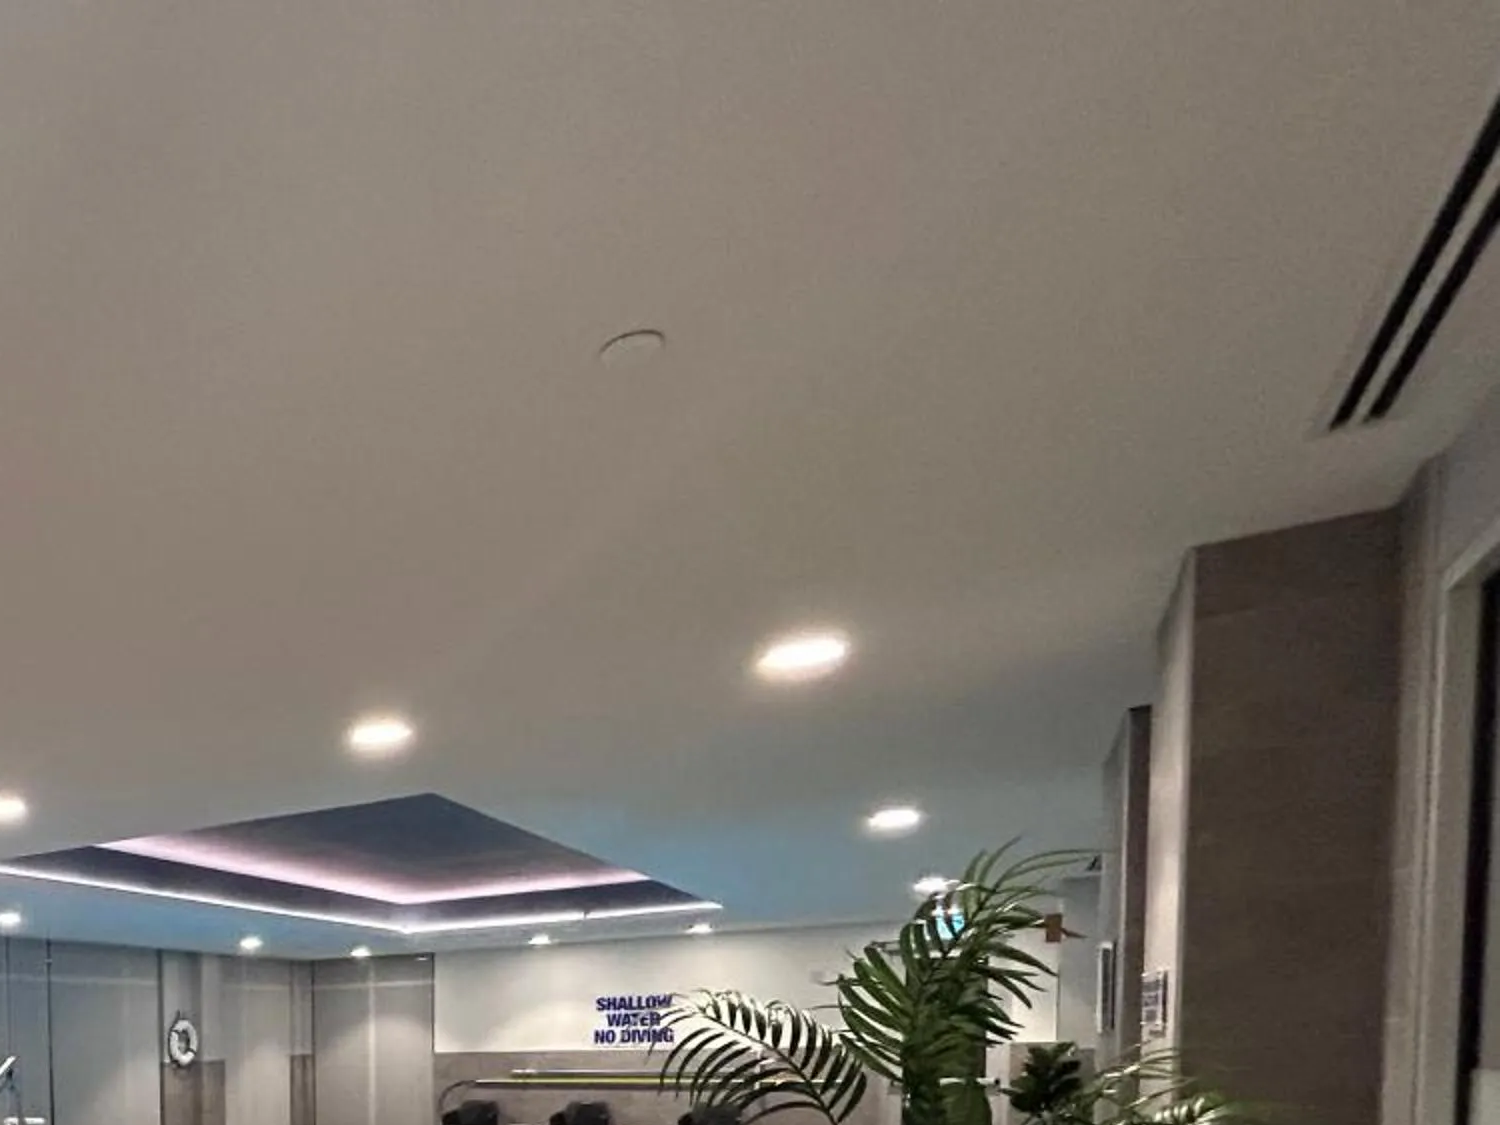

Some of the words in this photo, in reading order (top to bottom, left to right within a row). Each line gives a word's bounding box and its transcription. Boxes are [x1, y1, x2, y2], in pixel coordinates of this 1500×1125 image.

[595, 994, 672, 1011] SHALLOW
[606, 1011, 661, 1026] WATER
[594, 1029, 616, 1043] NO
[620, 1027, 675, 1042] DIVING
